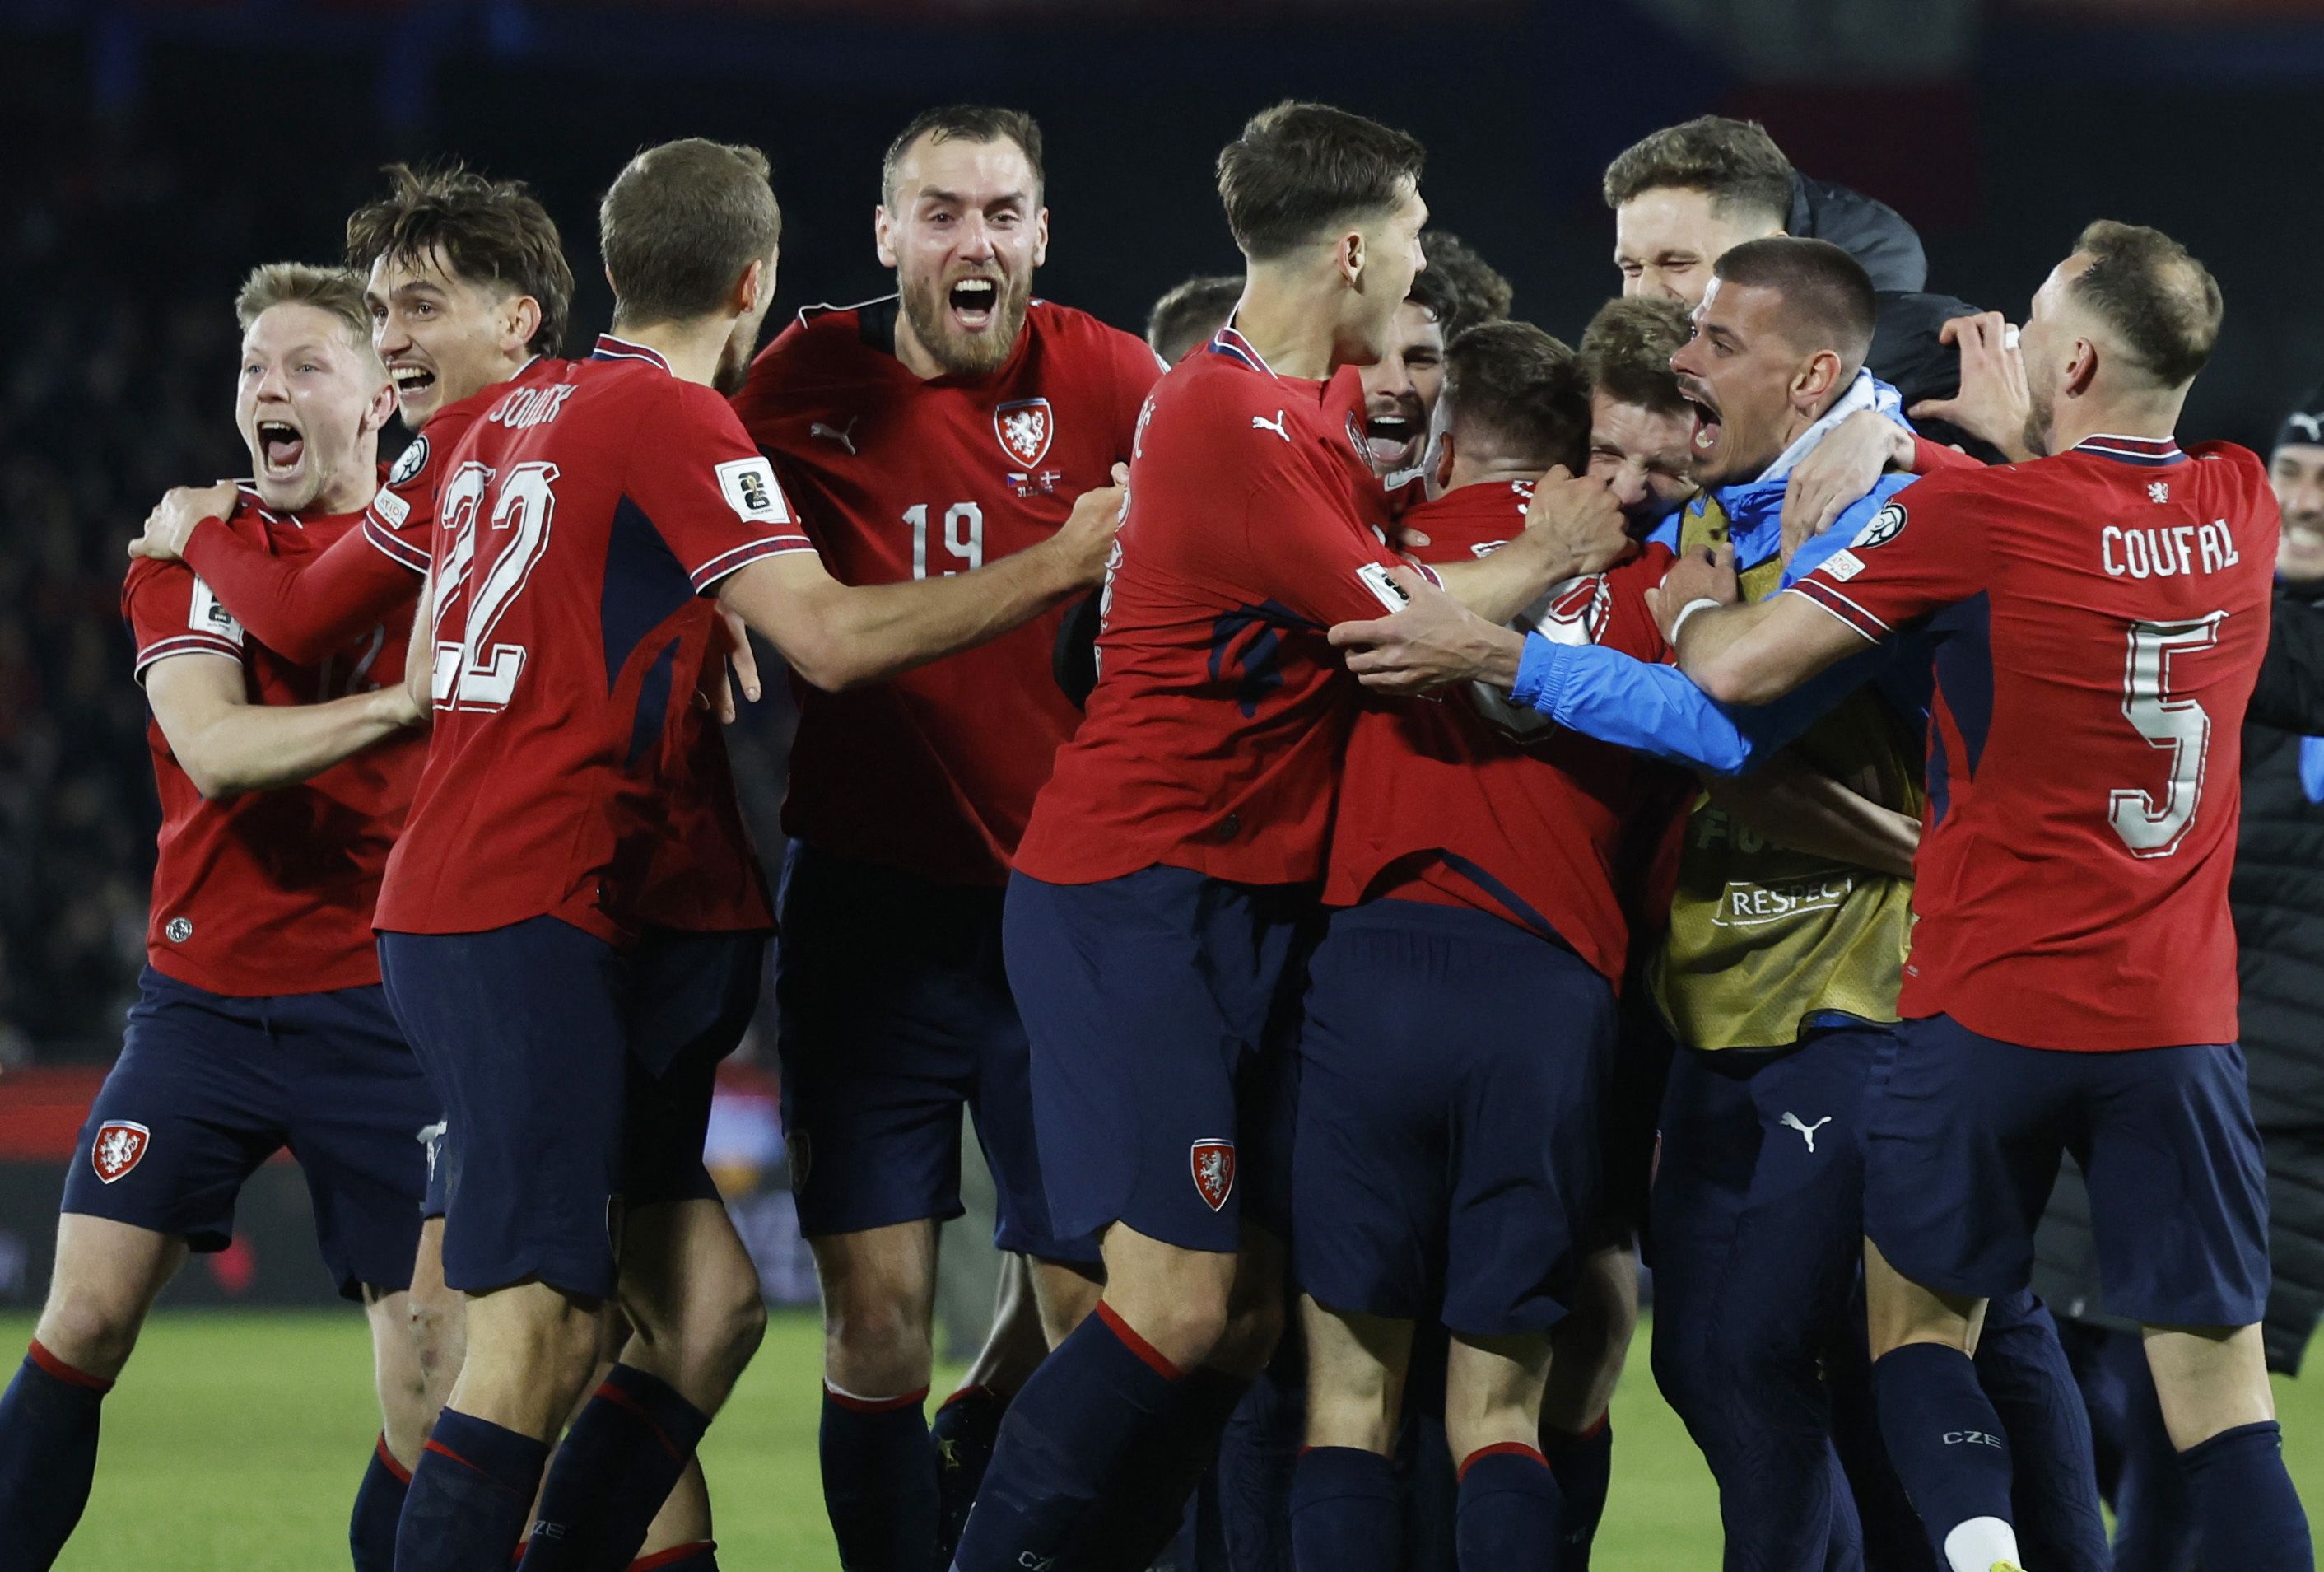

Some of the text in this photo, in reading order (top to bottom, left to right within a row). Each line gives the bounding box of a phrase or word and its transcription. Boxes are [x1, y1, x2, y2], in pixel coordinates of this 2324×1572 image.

[902, 501, 983, 581] 19
[2103, 519, 2239, 579] COUFAL
[431, 462, 561, 712] 22
[2108, 609, 2229, 858] 5
[1731, 875, 1853, 916] RESPECT
[1943, 1430, 2002, 1449] CZE
[531, 1520, 566, 1540] ZE
